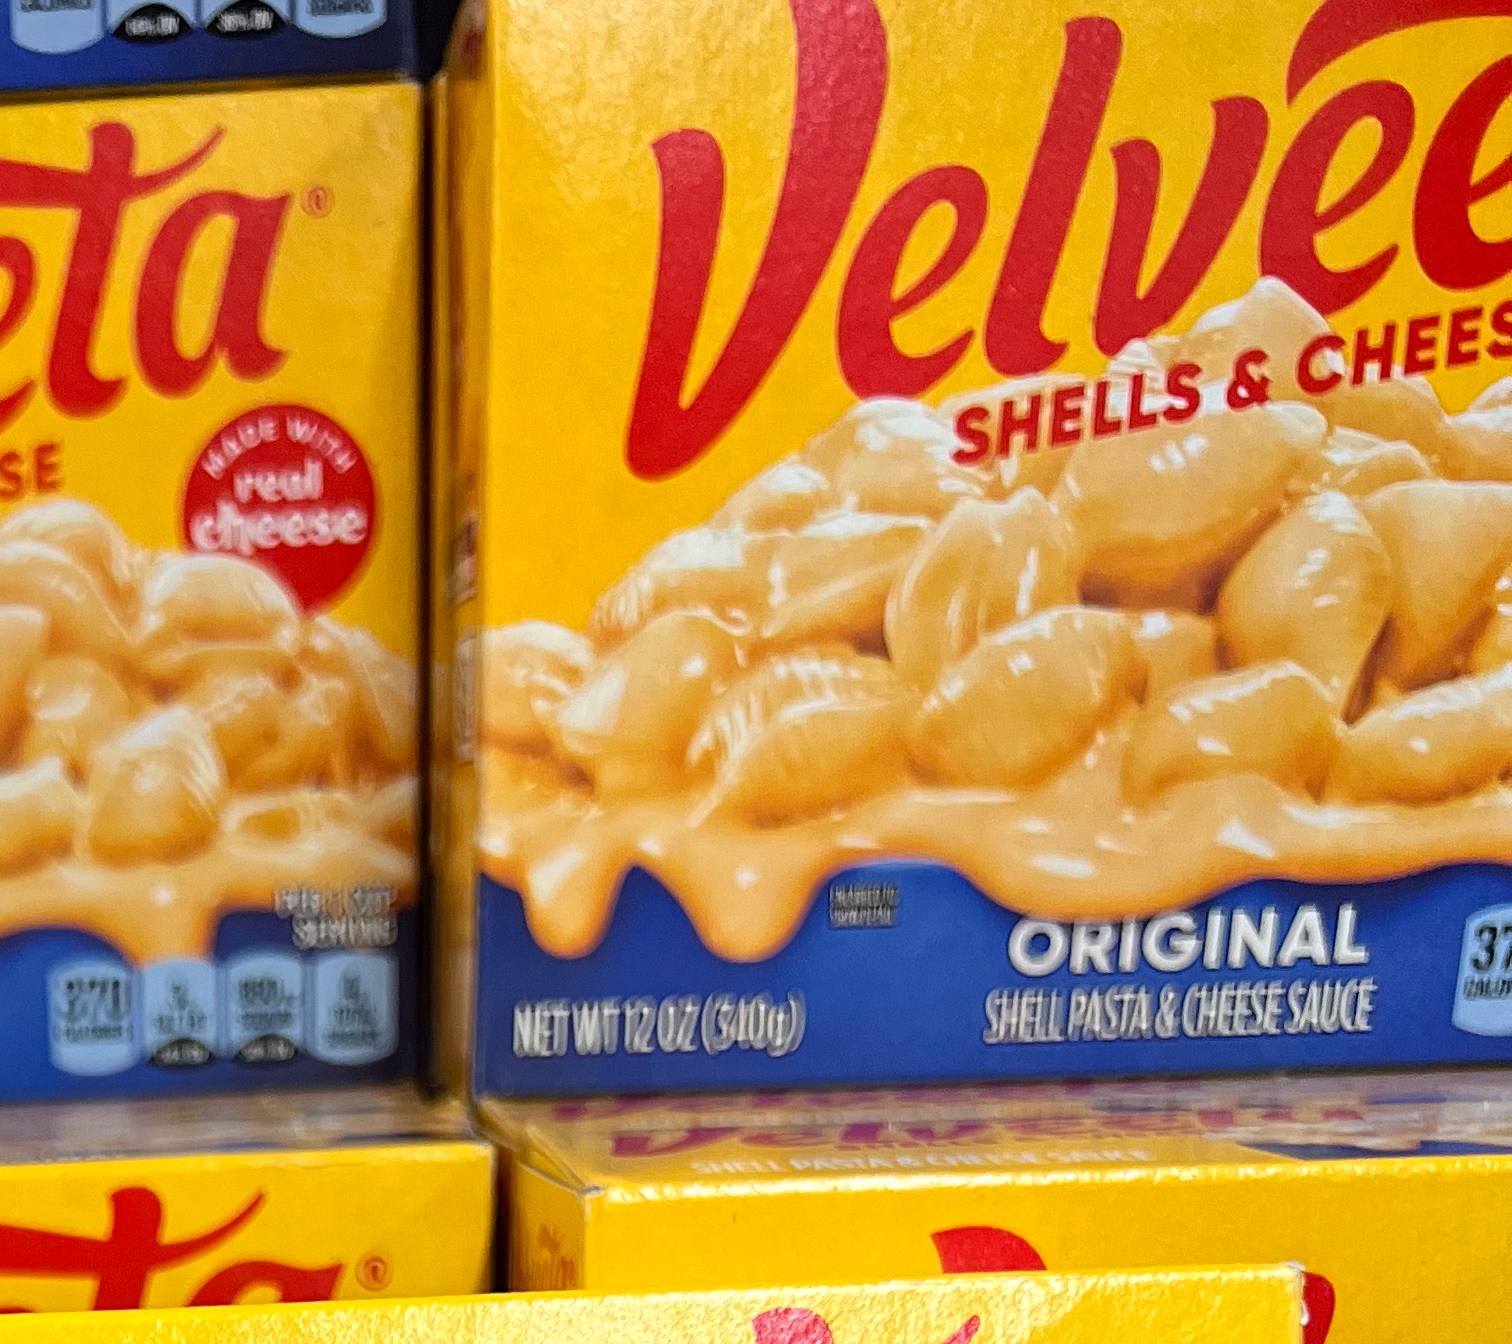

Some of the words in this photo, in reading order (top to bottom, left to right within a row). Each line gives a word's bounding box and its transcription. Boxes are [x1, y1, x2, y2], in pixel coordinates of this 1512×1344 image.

[951, 363, 1202, 467] SHELLS
[1226, 349, 1271, 411] &
[201, 416, 279, 480] MADE
[286, 415, 358, 475] WITH
[233, 456, 324, 503] real
[190, 498, 368, 556] cheese
[1007, 902, 1371, 978] ORIGINAL
[512, 1000, 570, 1058] NET
[572, 998, 620, 1056] WT
[624, 996, 656, 1054] 12
[657, 994, 699, 1053] OZ
[983, 986, 1065, 1044] SHELL
[1068, 985, 1153, 1042] PASTA
[1154, 984, 1181, 1039] &
[1182, 980, 1284, 1037] CHEESE
[1284, 976, 1378, 1034] SAUCE
